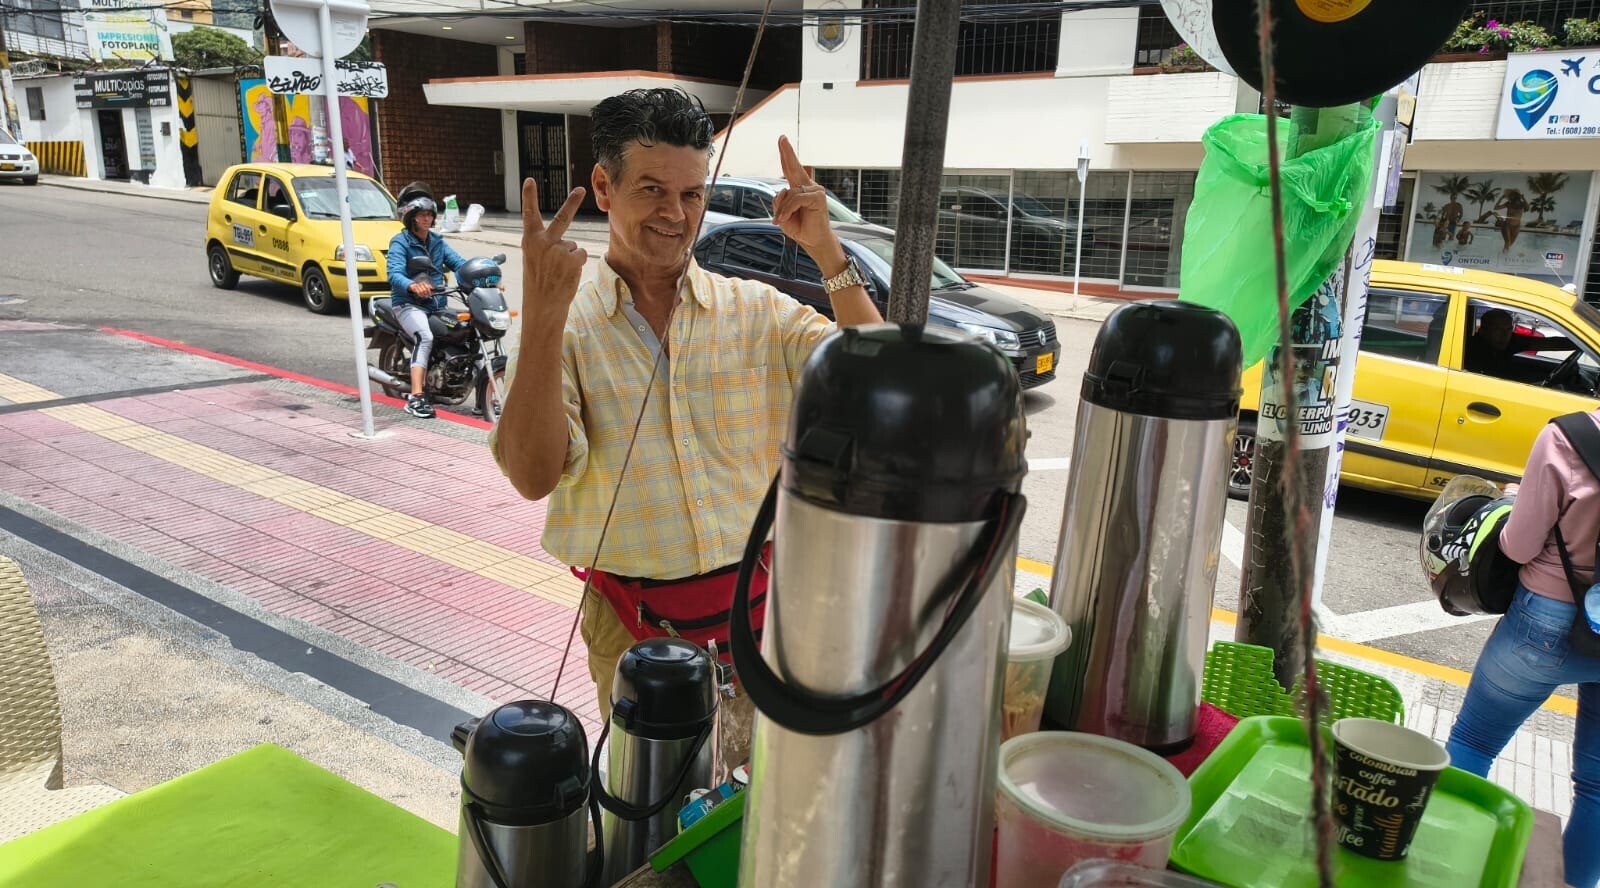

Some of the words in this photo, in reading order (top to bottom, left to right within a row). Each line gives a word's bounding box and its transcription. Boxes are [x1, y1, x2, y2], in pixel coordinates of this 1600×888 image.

[97, 32, 160, 42] IMPRESIONES
[102, 41, 159, 51] FOTOPLANO
[94, 77, 145, 93] MULTICopias
[1263, 404, 1275, 418] EL
[1276, 404, 1331, 420] CERPO
[1346, 408, 1384, 428] 933
[1349, 751, 1418, 777] colombian
[1358, 770, 1396, 786] coffee
